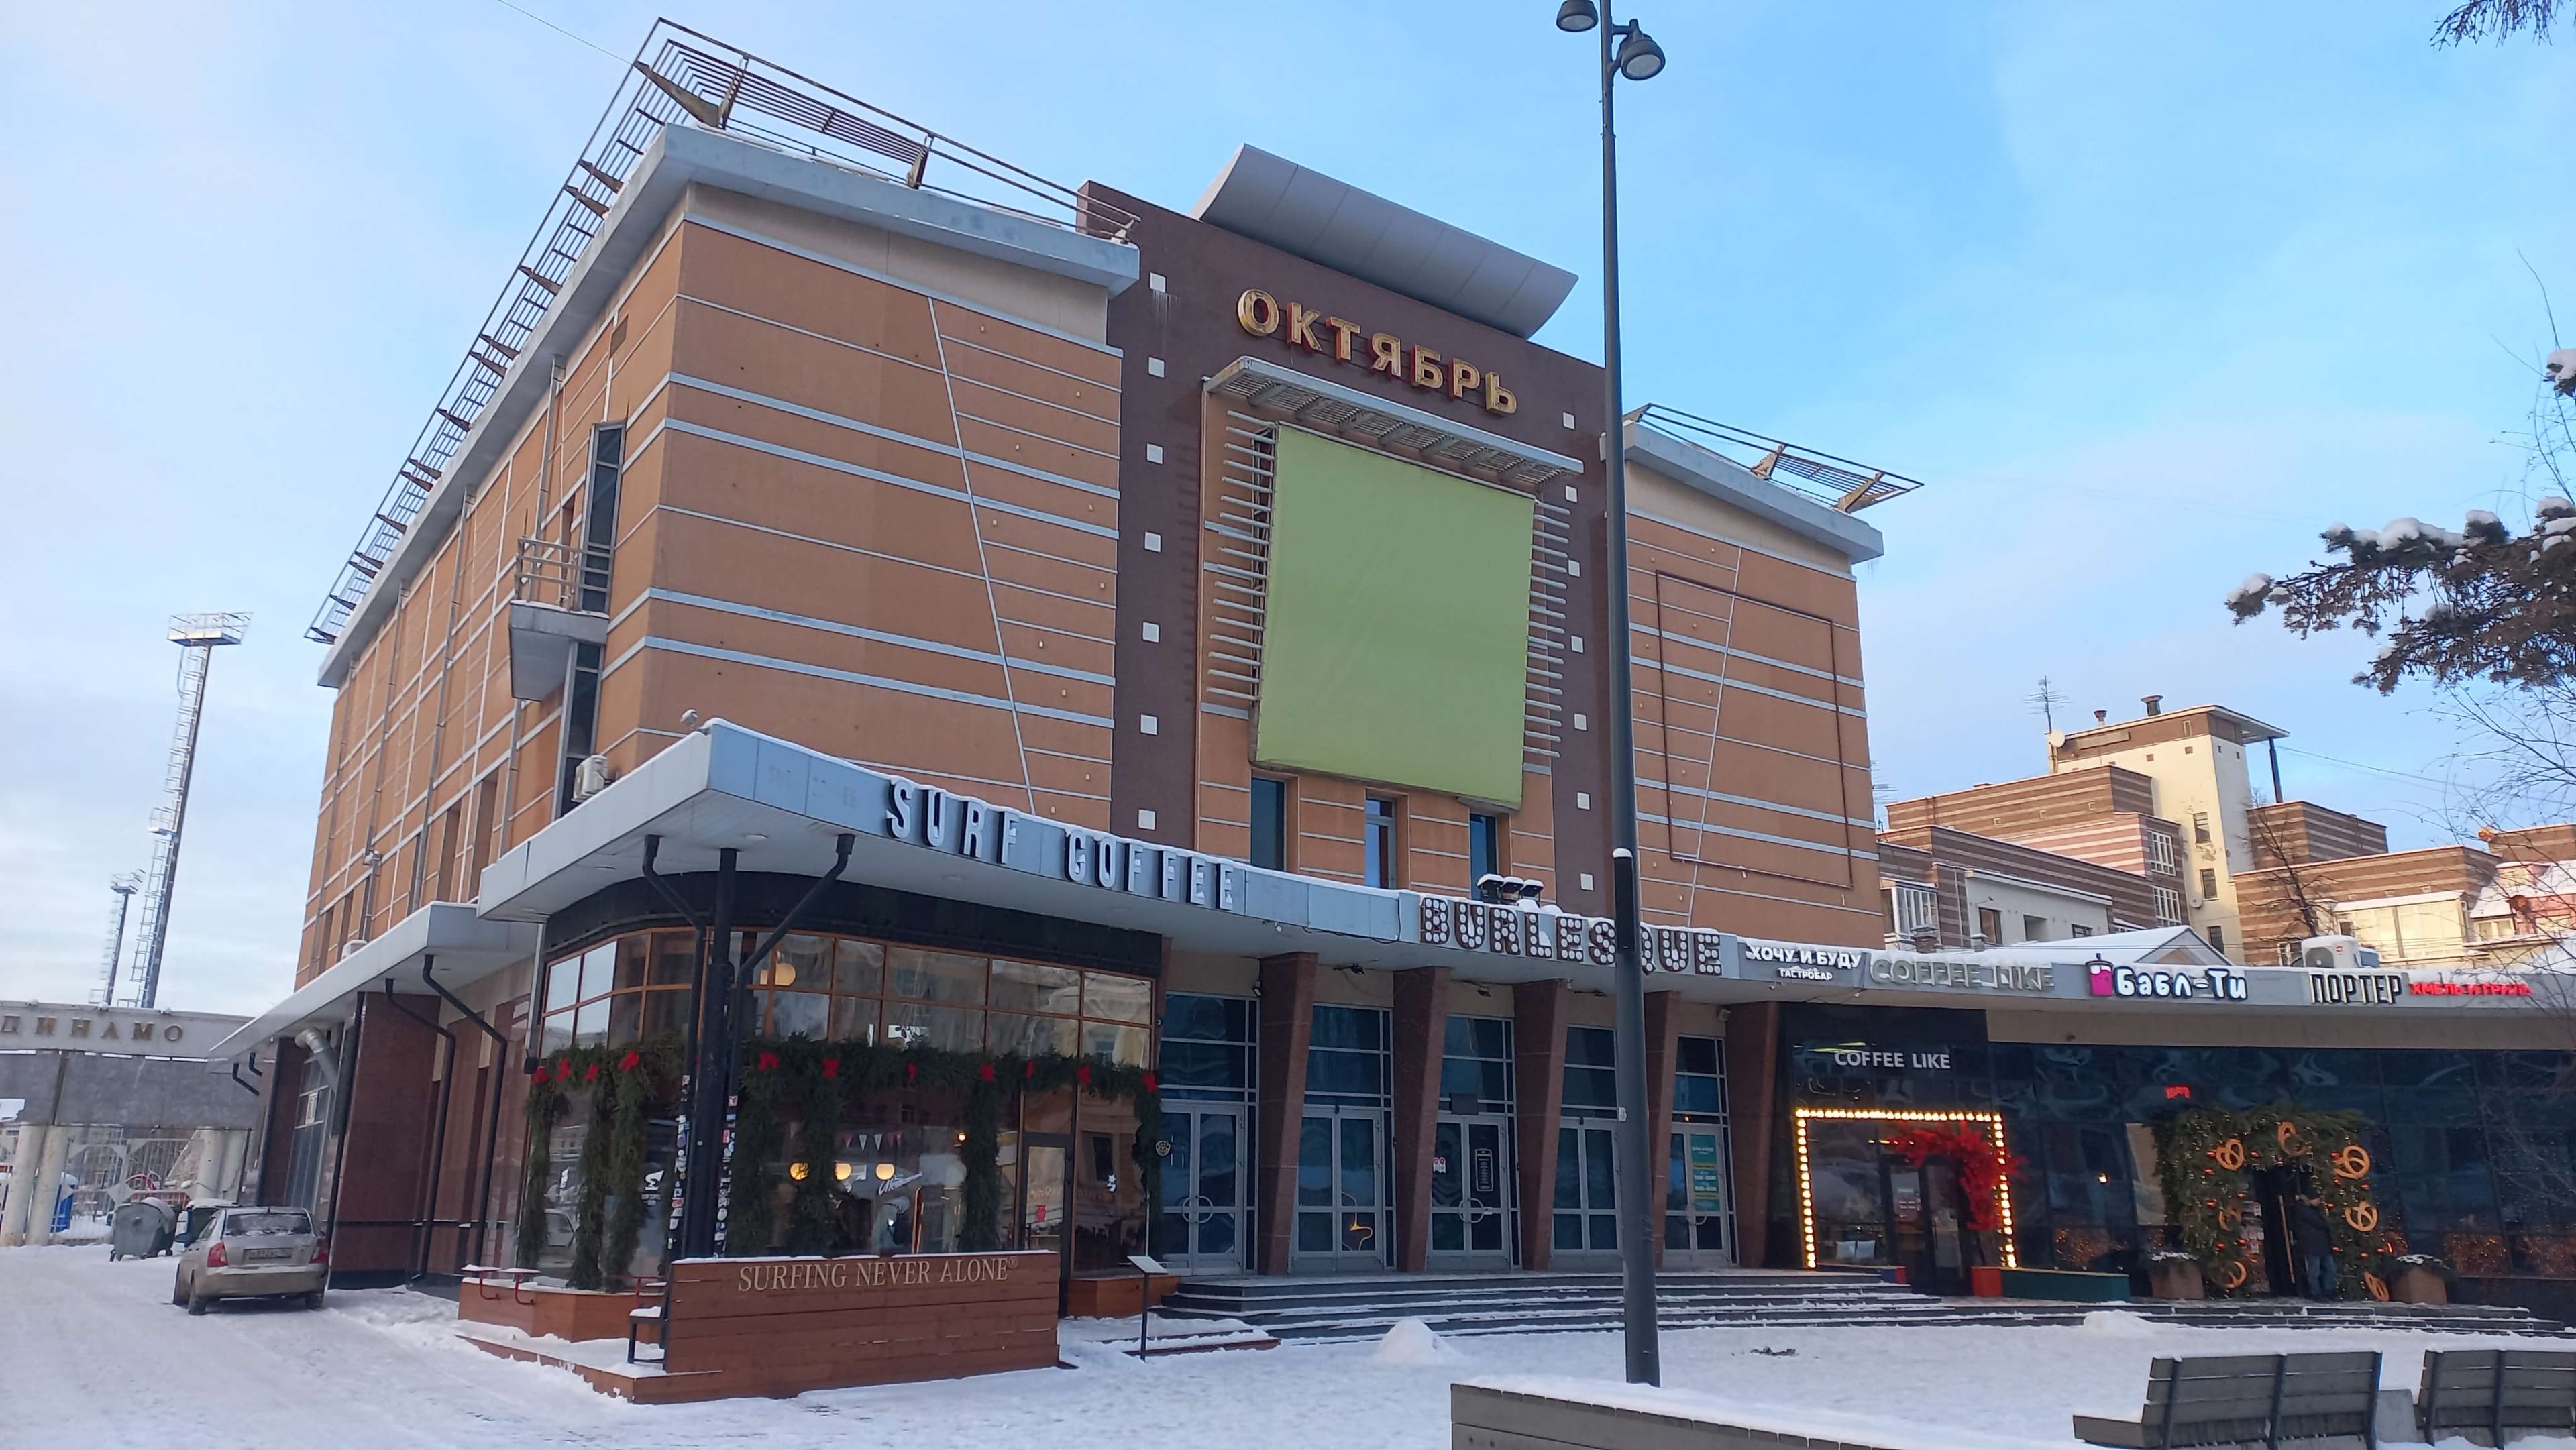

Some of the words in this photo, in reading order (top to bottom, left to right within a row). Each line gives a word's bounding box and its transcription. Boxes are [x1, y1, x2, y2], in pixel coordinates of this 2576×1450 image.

[1237, 288, 1518, 415] ОКТЯБРЬ
[886, 779, 1020, 865] SURF
[1065, 828, 1234, 911] COFFEE
[1746, 945, 1795, 964] ХОЧУ
[1799, 949, 1813, 964] И
[1816, 950, 1862, 970] БУДУ
[1779, 968, 1833, 981] ГАСТРОБАР
[1870, 959, 1981, 988] COFFEE
[1993, 964, 2055, 991] LIKE
[2308, 973, 2402, 1005] ПОРТЕР
[2465, 983, 2480, 995] И
[0, 1014, 184, 1042] ДИНАМО
[1835, 1051, 1905, 1068] COFFEE
[1912, 1052, 1951, 1069] LIKE
[738, 1263, 847, 1292] SURFING
[855, 1261, 931, 1287] NEVER
